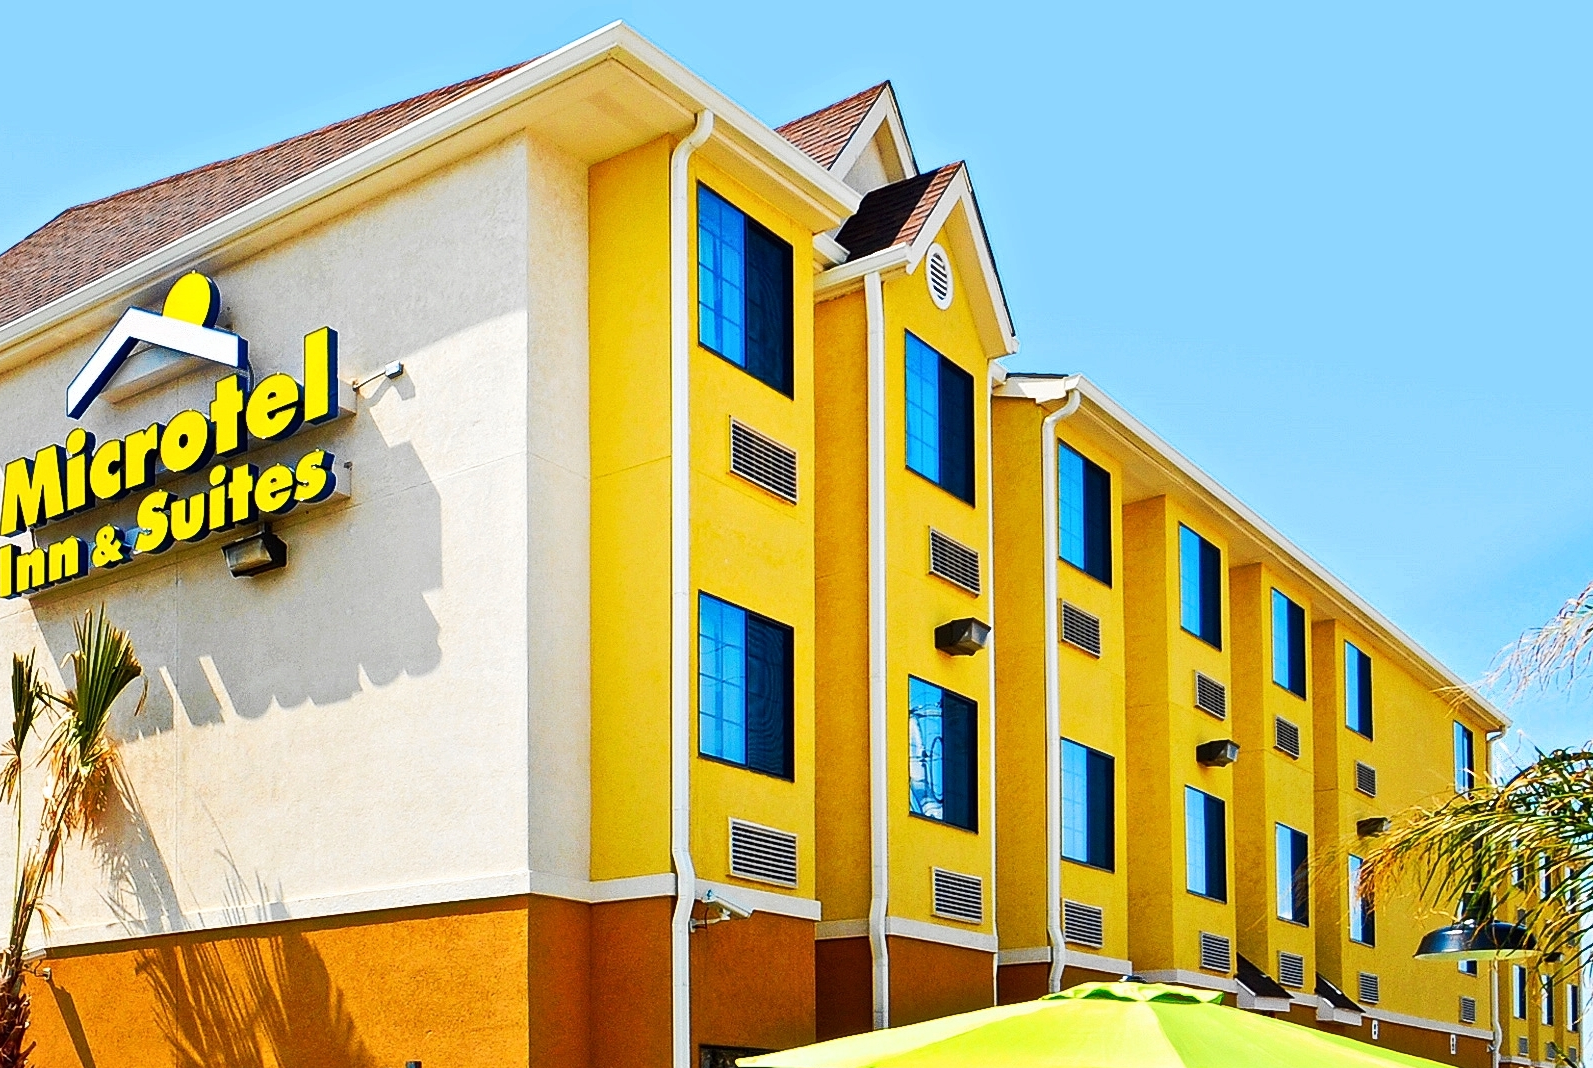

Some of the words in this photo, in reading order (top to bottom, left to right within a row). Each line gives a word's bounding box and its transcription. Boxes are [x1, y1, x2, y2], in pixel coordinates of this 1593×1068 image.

[0, 326, 339, 538] Microtel
[91, 523, 132, 569] &
[135, 449, 337, 555] Suites
